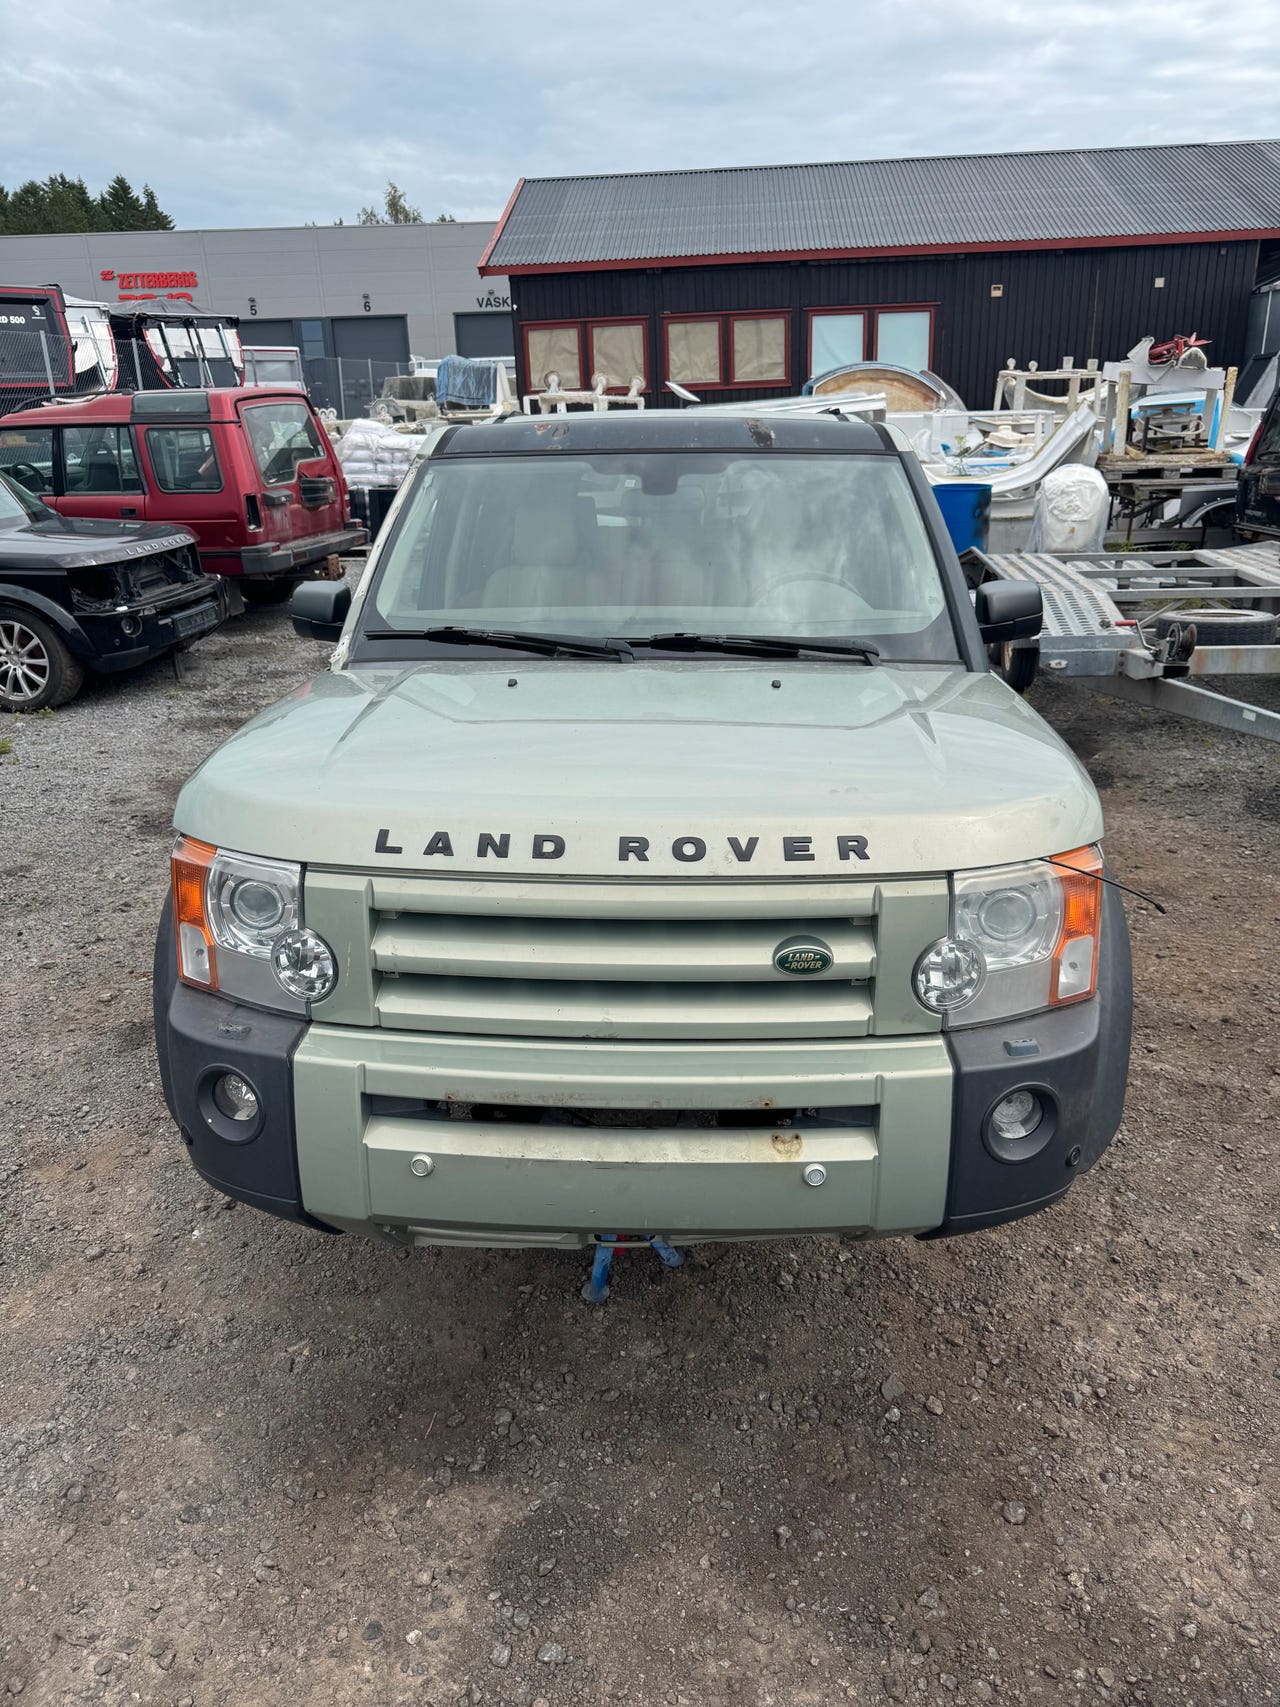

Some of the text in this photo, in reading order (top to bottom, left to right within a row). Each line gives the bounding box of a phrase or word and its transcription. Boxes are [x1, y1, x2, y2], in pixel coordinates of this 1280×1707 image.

[117, 271, 198, 289] ZETTERBERGS
[363, 301, 372, 313] 6
[476, 296, 511, 308] VASK
[249, 304, 258, 316] 5
[0, 315, 8, 324] D
[10, 315, 26, 324] 500
[126, 543, 159, 556] LAND
[375, 828, 871, 862] LAND ROVER
[788, 952, 815, 962] LAND
[790, 961, 823, 969] ROVER
